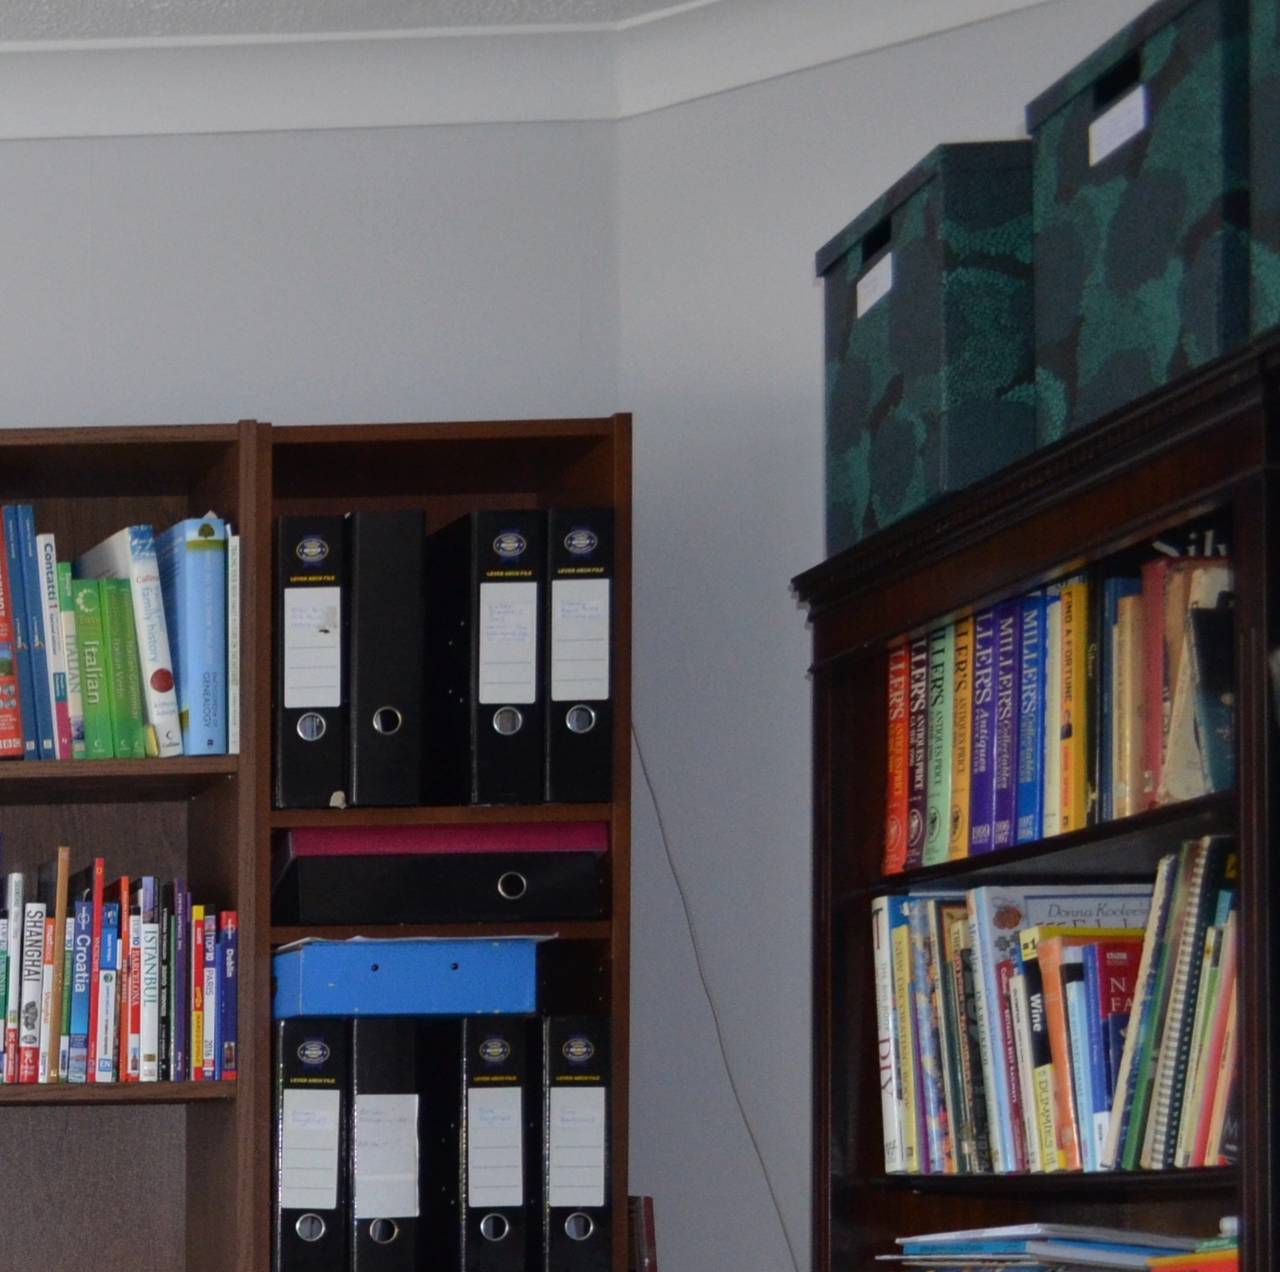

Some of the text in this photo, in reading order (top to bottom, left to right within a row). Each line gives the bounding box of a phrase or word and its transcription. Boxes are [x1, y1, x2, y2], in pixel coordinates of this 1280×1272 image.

[43, 543, 57, 600] Contatti
[141, 587, 160, 662] family history
[84, 641, 102, 704] Italian
[998, 618, 1014, 720] MILLER'S
[1021, 610, 1038, 714] MILLER'S
[1064, 640, 1072, 703] FORTUNE
[202, 671, 211, 727] GENEALOGY
[977, 708, 989, 773] Antiques
[1048, 903, 1095, 917] Donna
[24, 910, 44, 982] SHANGHAI
[75, 934, 91, 993] Croatia
[143, 930, 158, 1008] ISTANBUL
[225, 948, 235, 978] Dublin
[131, 949, 140, 1007] BARCELONA
[205, 970, 214, 996] PARIS
[877, 1036, 893, 1096] DIY
[1029, 993, 1054, 1149] Wine DUMMIES
